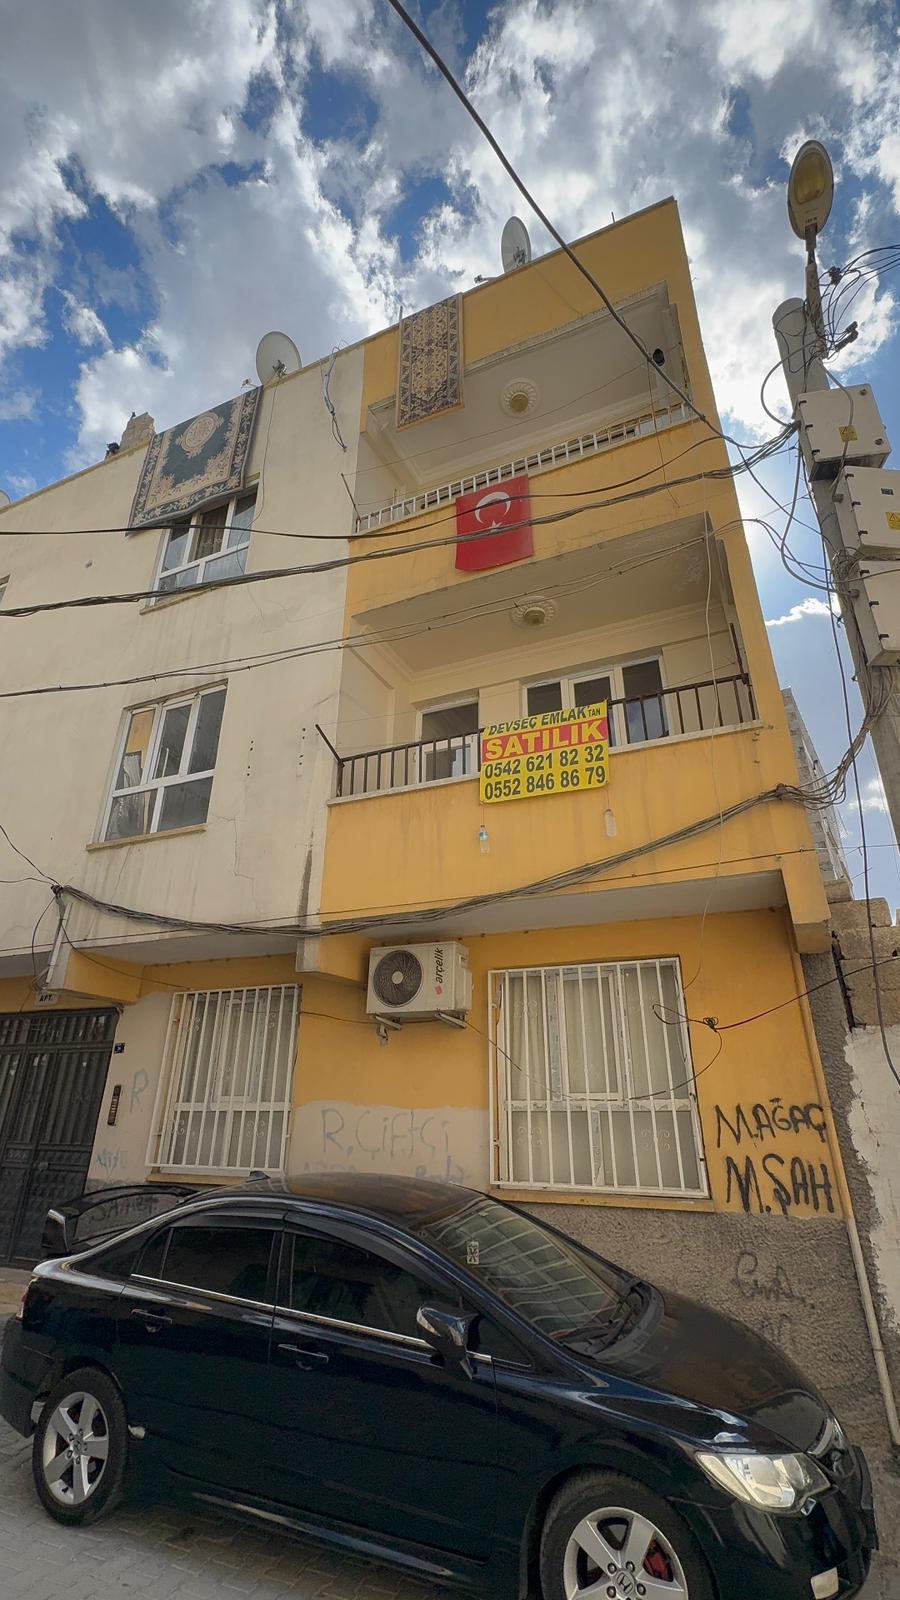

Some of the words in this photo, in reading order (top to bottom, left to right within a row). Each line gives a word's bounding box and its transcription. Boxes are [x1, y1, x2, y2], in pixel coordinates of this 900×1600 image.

[485, 719, 604, 761] SATILIK
[488, 716, 538, 736] DEVSEÇ
[484, 758, 521, 779] 0542
[526, 752, 553, 772] 621
[559, 748, 579, 767] 82
[584, 744, 605, 764] 32
[484, 777, 521, 800] 0552
[526, 772, 555, 794] 846
[560, 768, 580, 788] 86
[584, 765, 606, 785] 79
